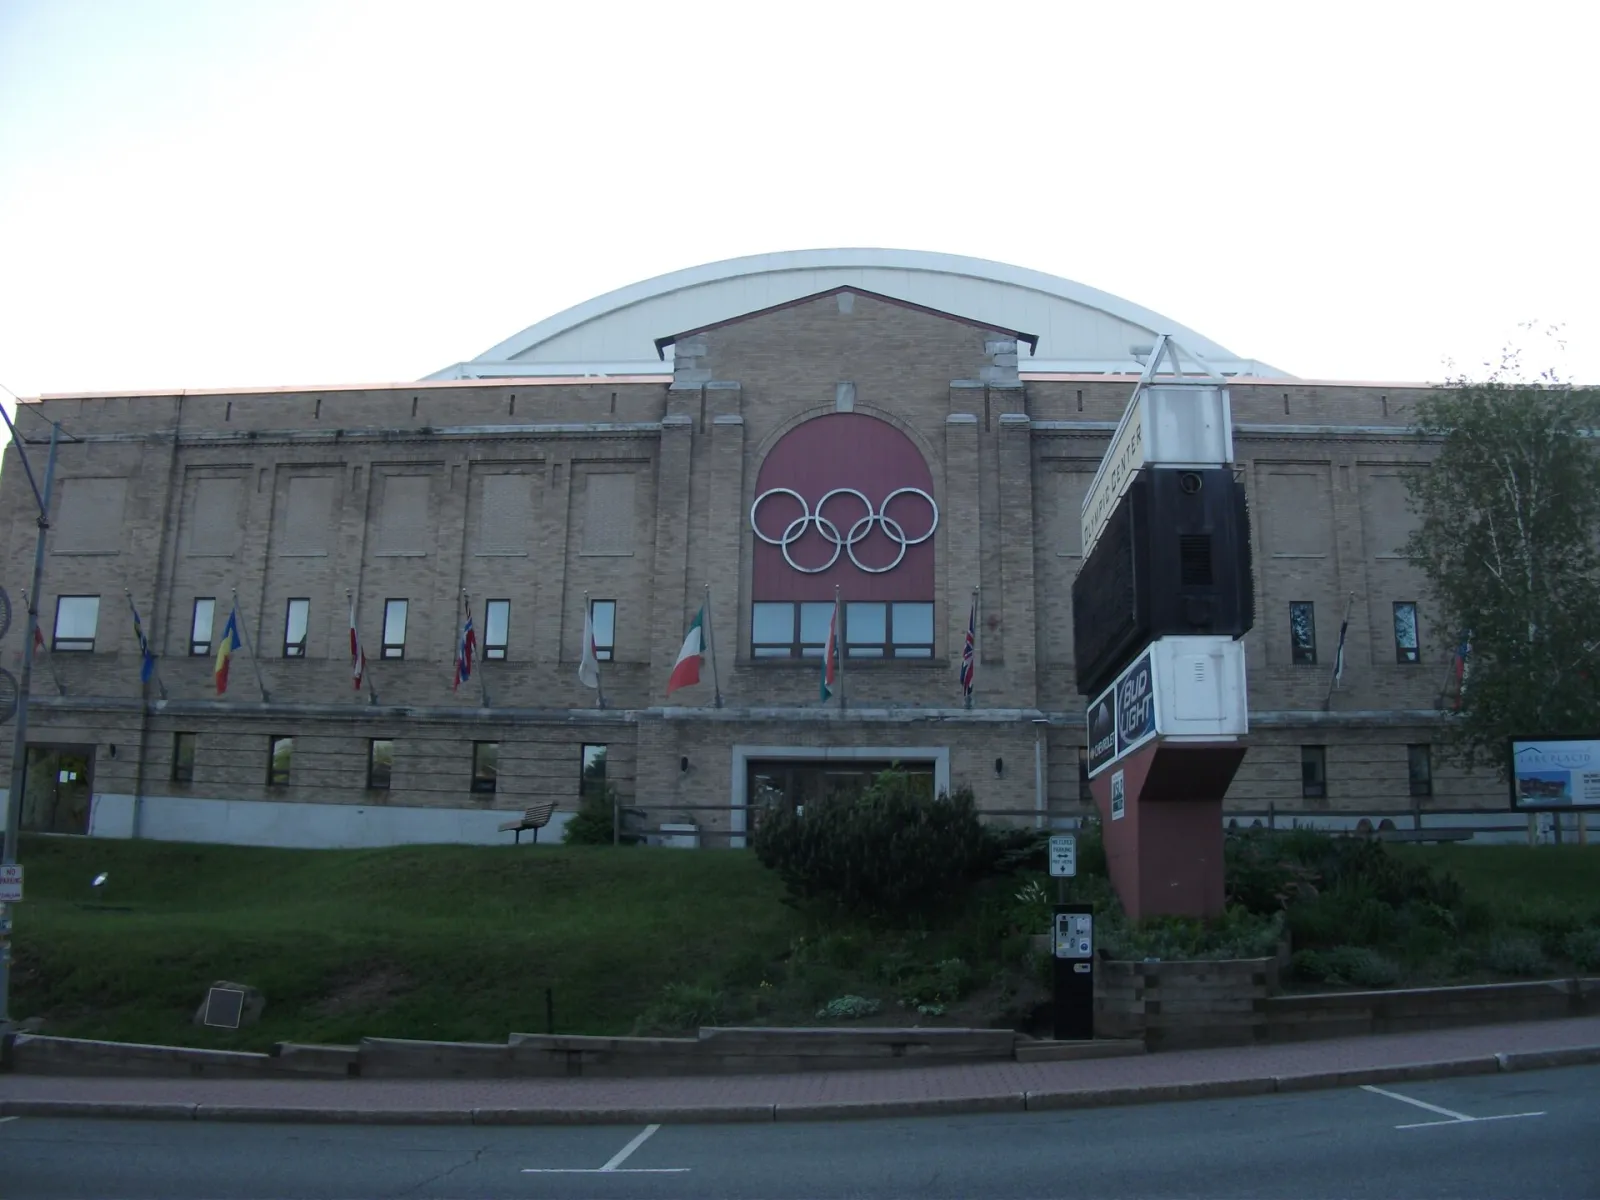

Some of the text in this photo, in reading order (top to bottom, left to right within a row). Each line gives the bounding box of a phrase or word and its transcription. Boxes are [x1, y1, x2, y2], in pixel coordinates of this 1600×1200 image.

[1084, 424, 1142, 546] OLYMPIC CENTER
[1123, 669, 1147, 709] BUD
[1121, 692, 1152, 735] LIGHT
[1094, 731, 1115, 757] CHEVROLET
[7, 868, 16, 876] NO
